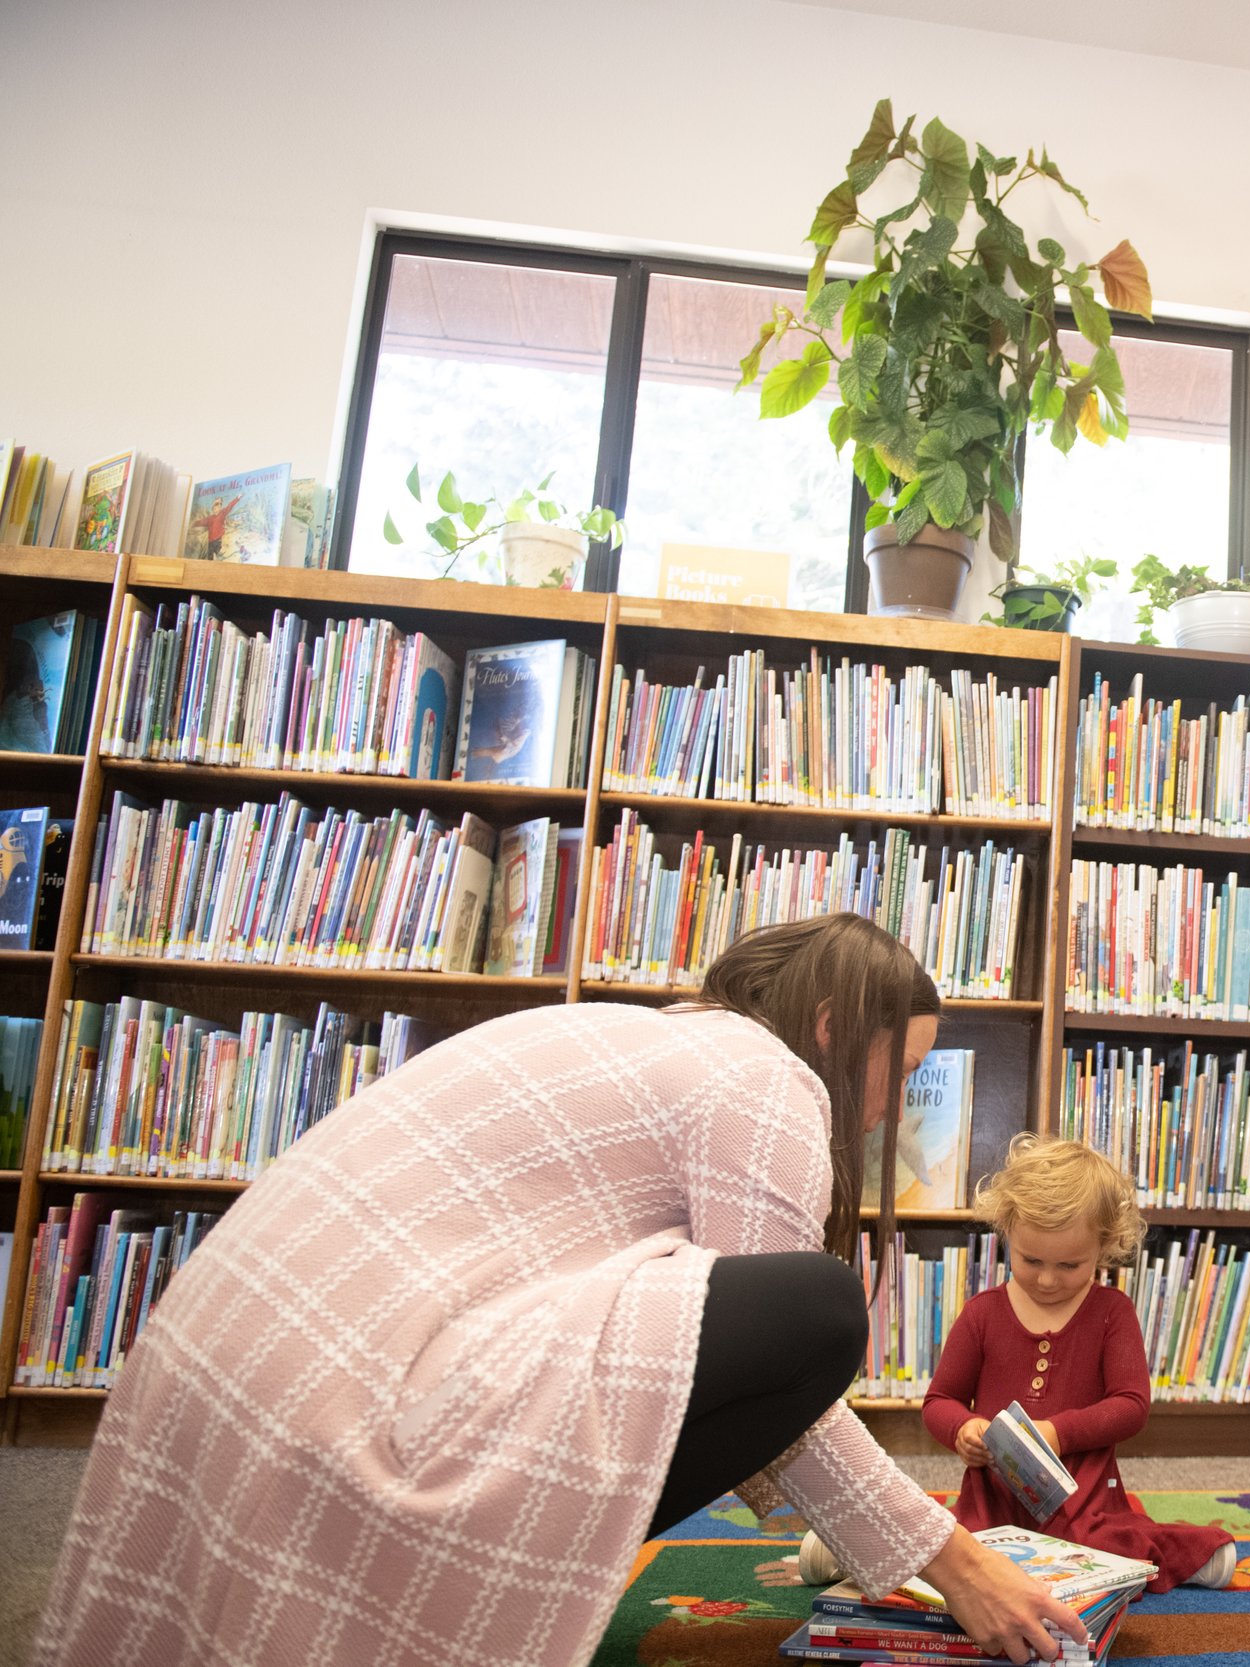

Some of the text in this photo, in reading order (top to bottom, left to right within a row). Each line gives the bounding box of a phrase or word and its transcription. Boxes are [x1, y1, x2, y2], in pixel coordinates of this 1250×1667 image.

[668, 564, 743, 587] Picture
[666, 582, 728, 603] Books
[0, 920, 28, 934] Moon
[907, 1088, 943, 1108] BIRD
[823, 1603, 944, 1623] FORSYTHE MINA
[878, 1639, 948, 1651] WE WANT A DOG
